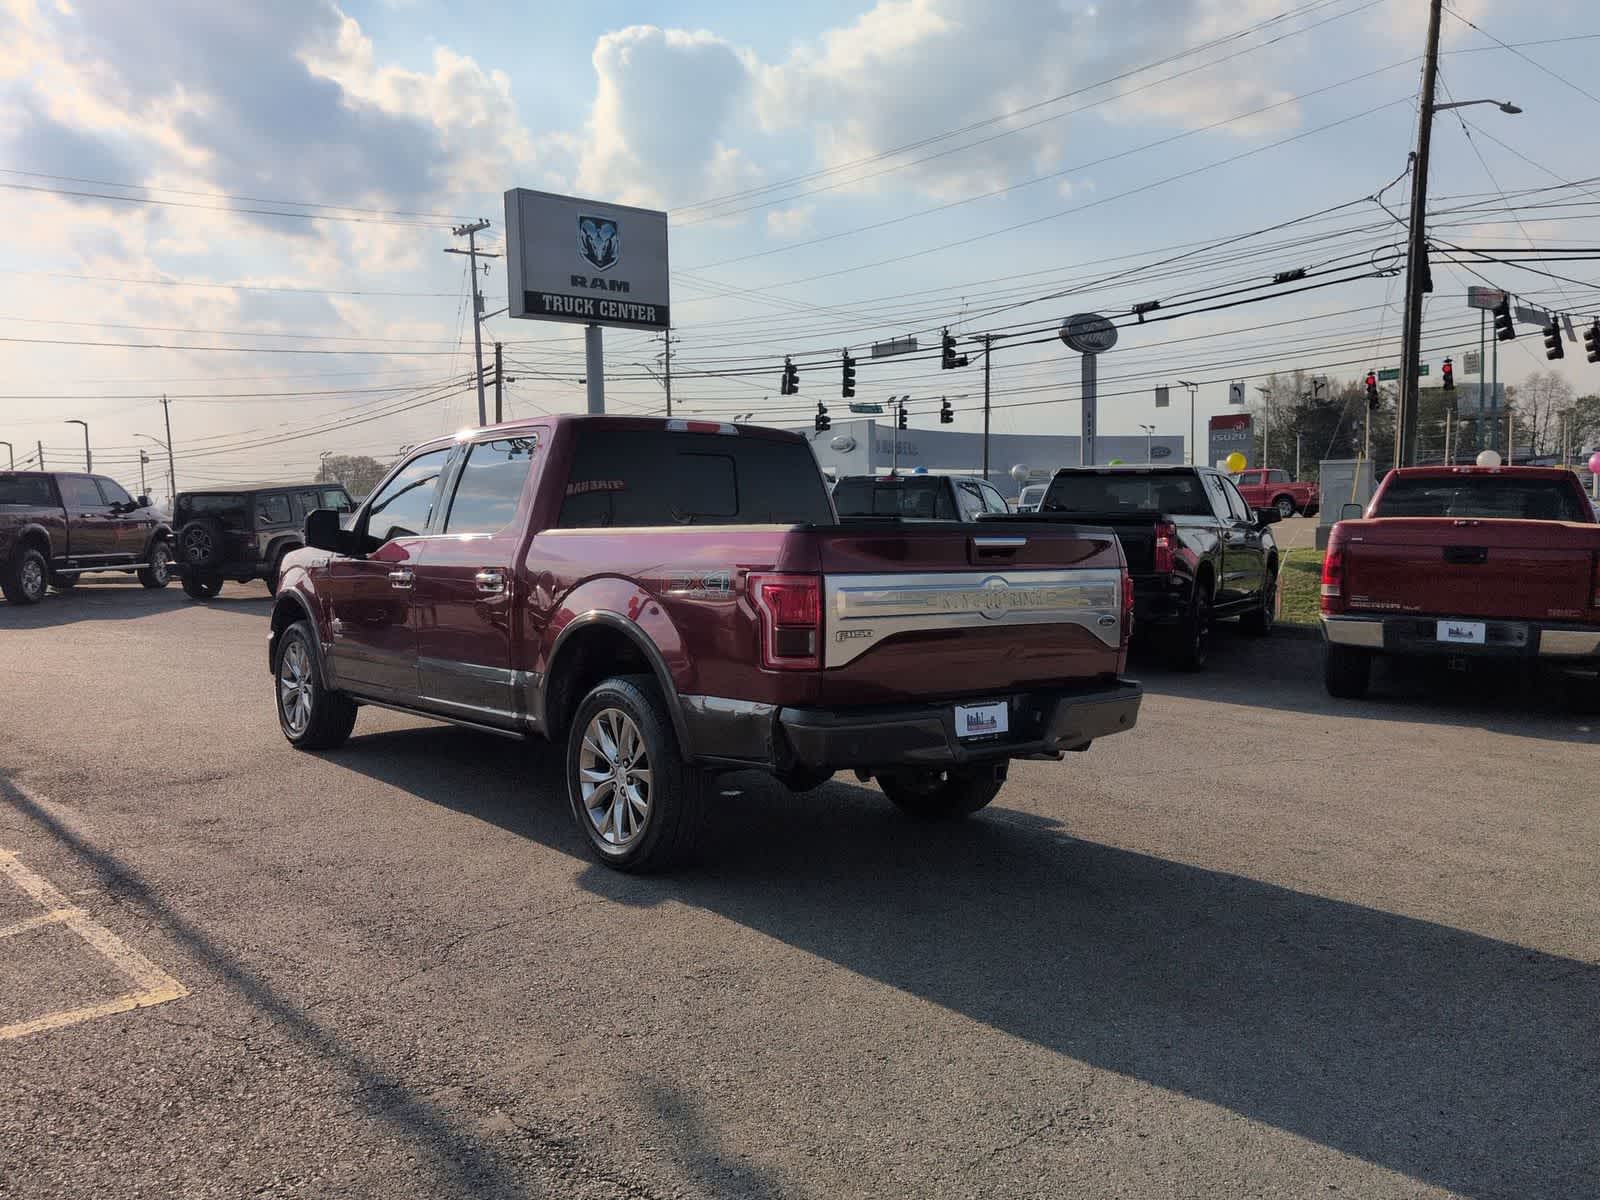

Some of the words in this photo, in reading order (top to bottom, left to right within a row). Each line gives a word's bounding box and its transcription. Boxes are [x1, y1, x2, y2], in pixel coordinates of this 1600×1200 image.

[570, 274, 630, 293] RAM
[542, 294, 594, 316] TRUCK
[600, 300, 656, 322] CENTER
[1212, 431, 1247, 441] ISUZU
